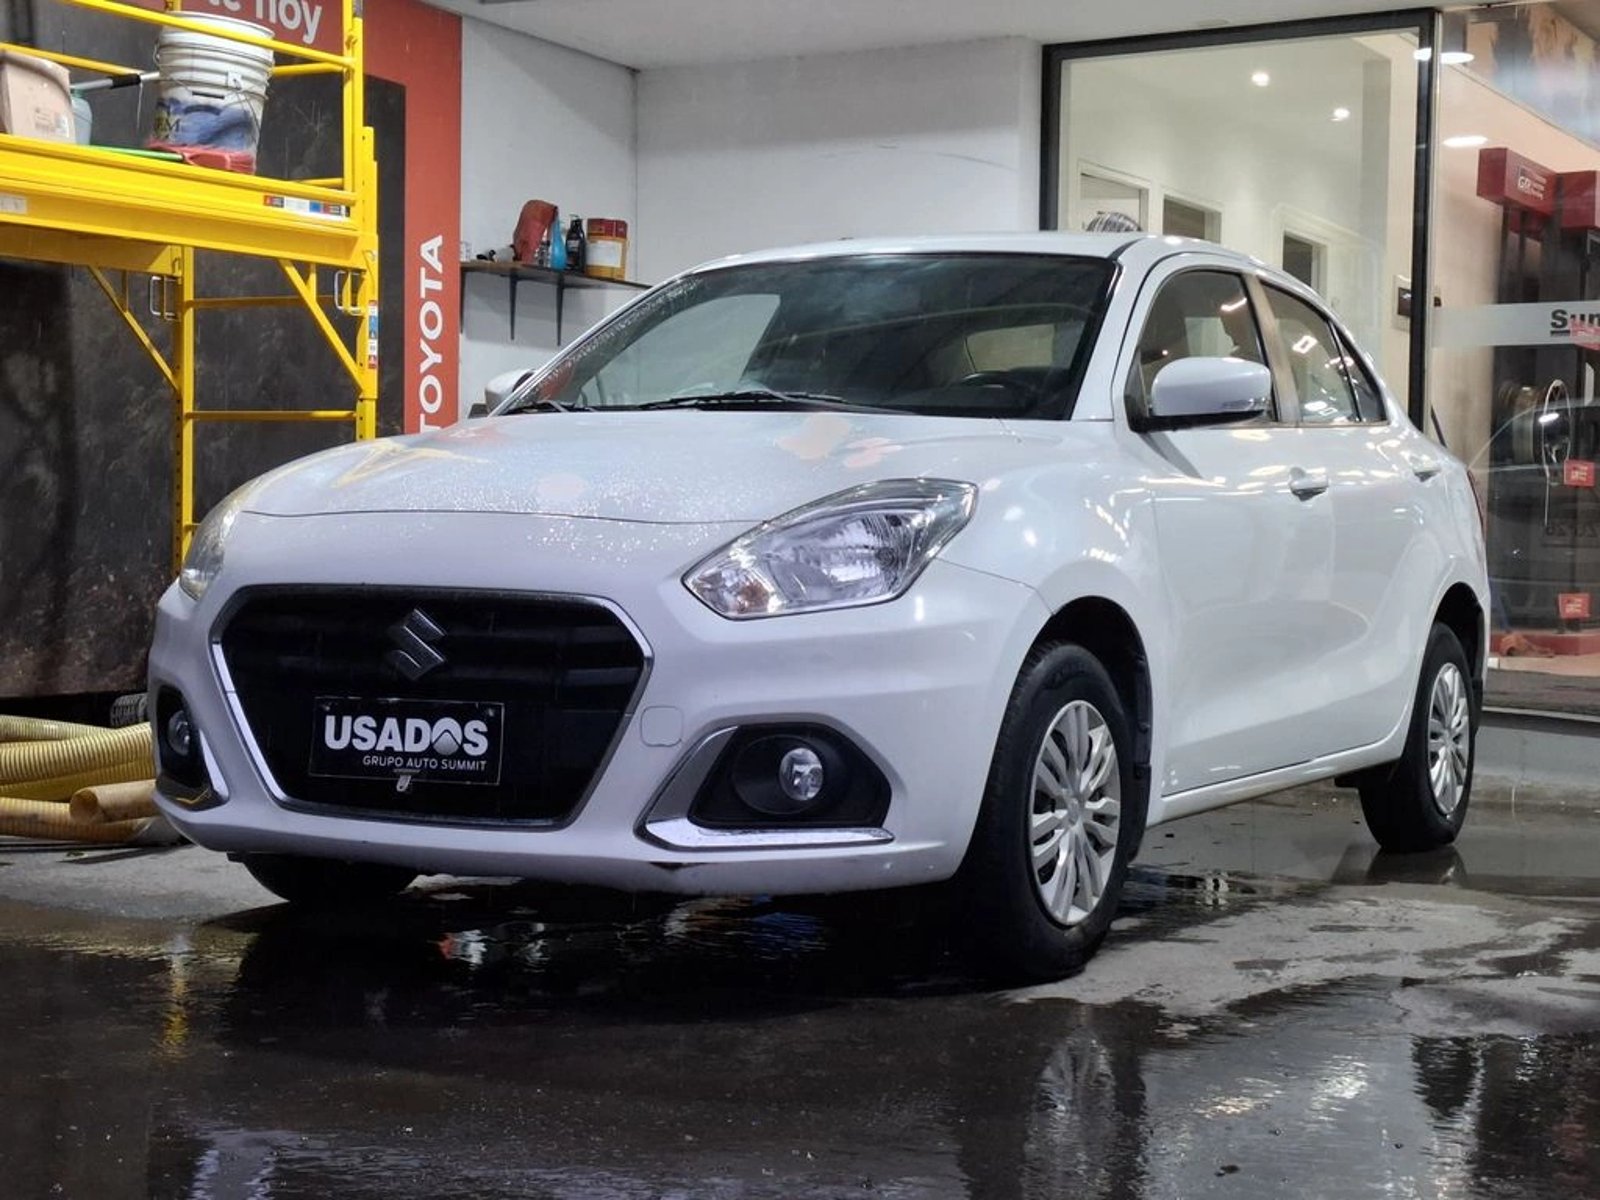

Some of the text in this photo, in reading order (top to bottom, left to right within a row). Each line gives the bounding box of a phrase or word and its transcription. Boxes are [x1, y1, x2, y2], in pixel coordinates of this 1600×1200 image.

[419, 234, 443, 434] TOYOTA
[324, 715, 488, 756] USADOS
[362, 755, 487, 771] GRUPO AUTO SUMMIT
